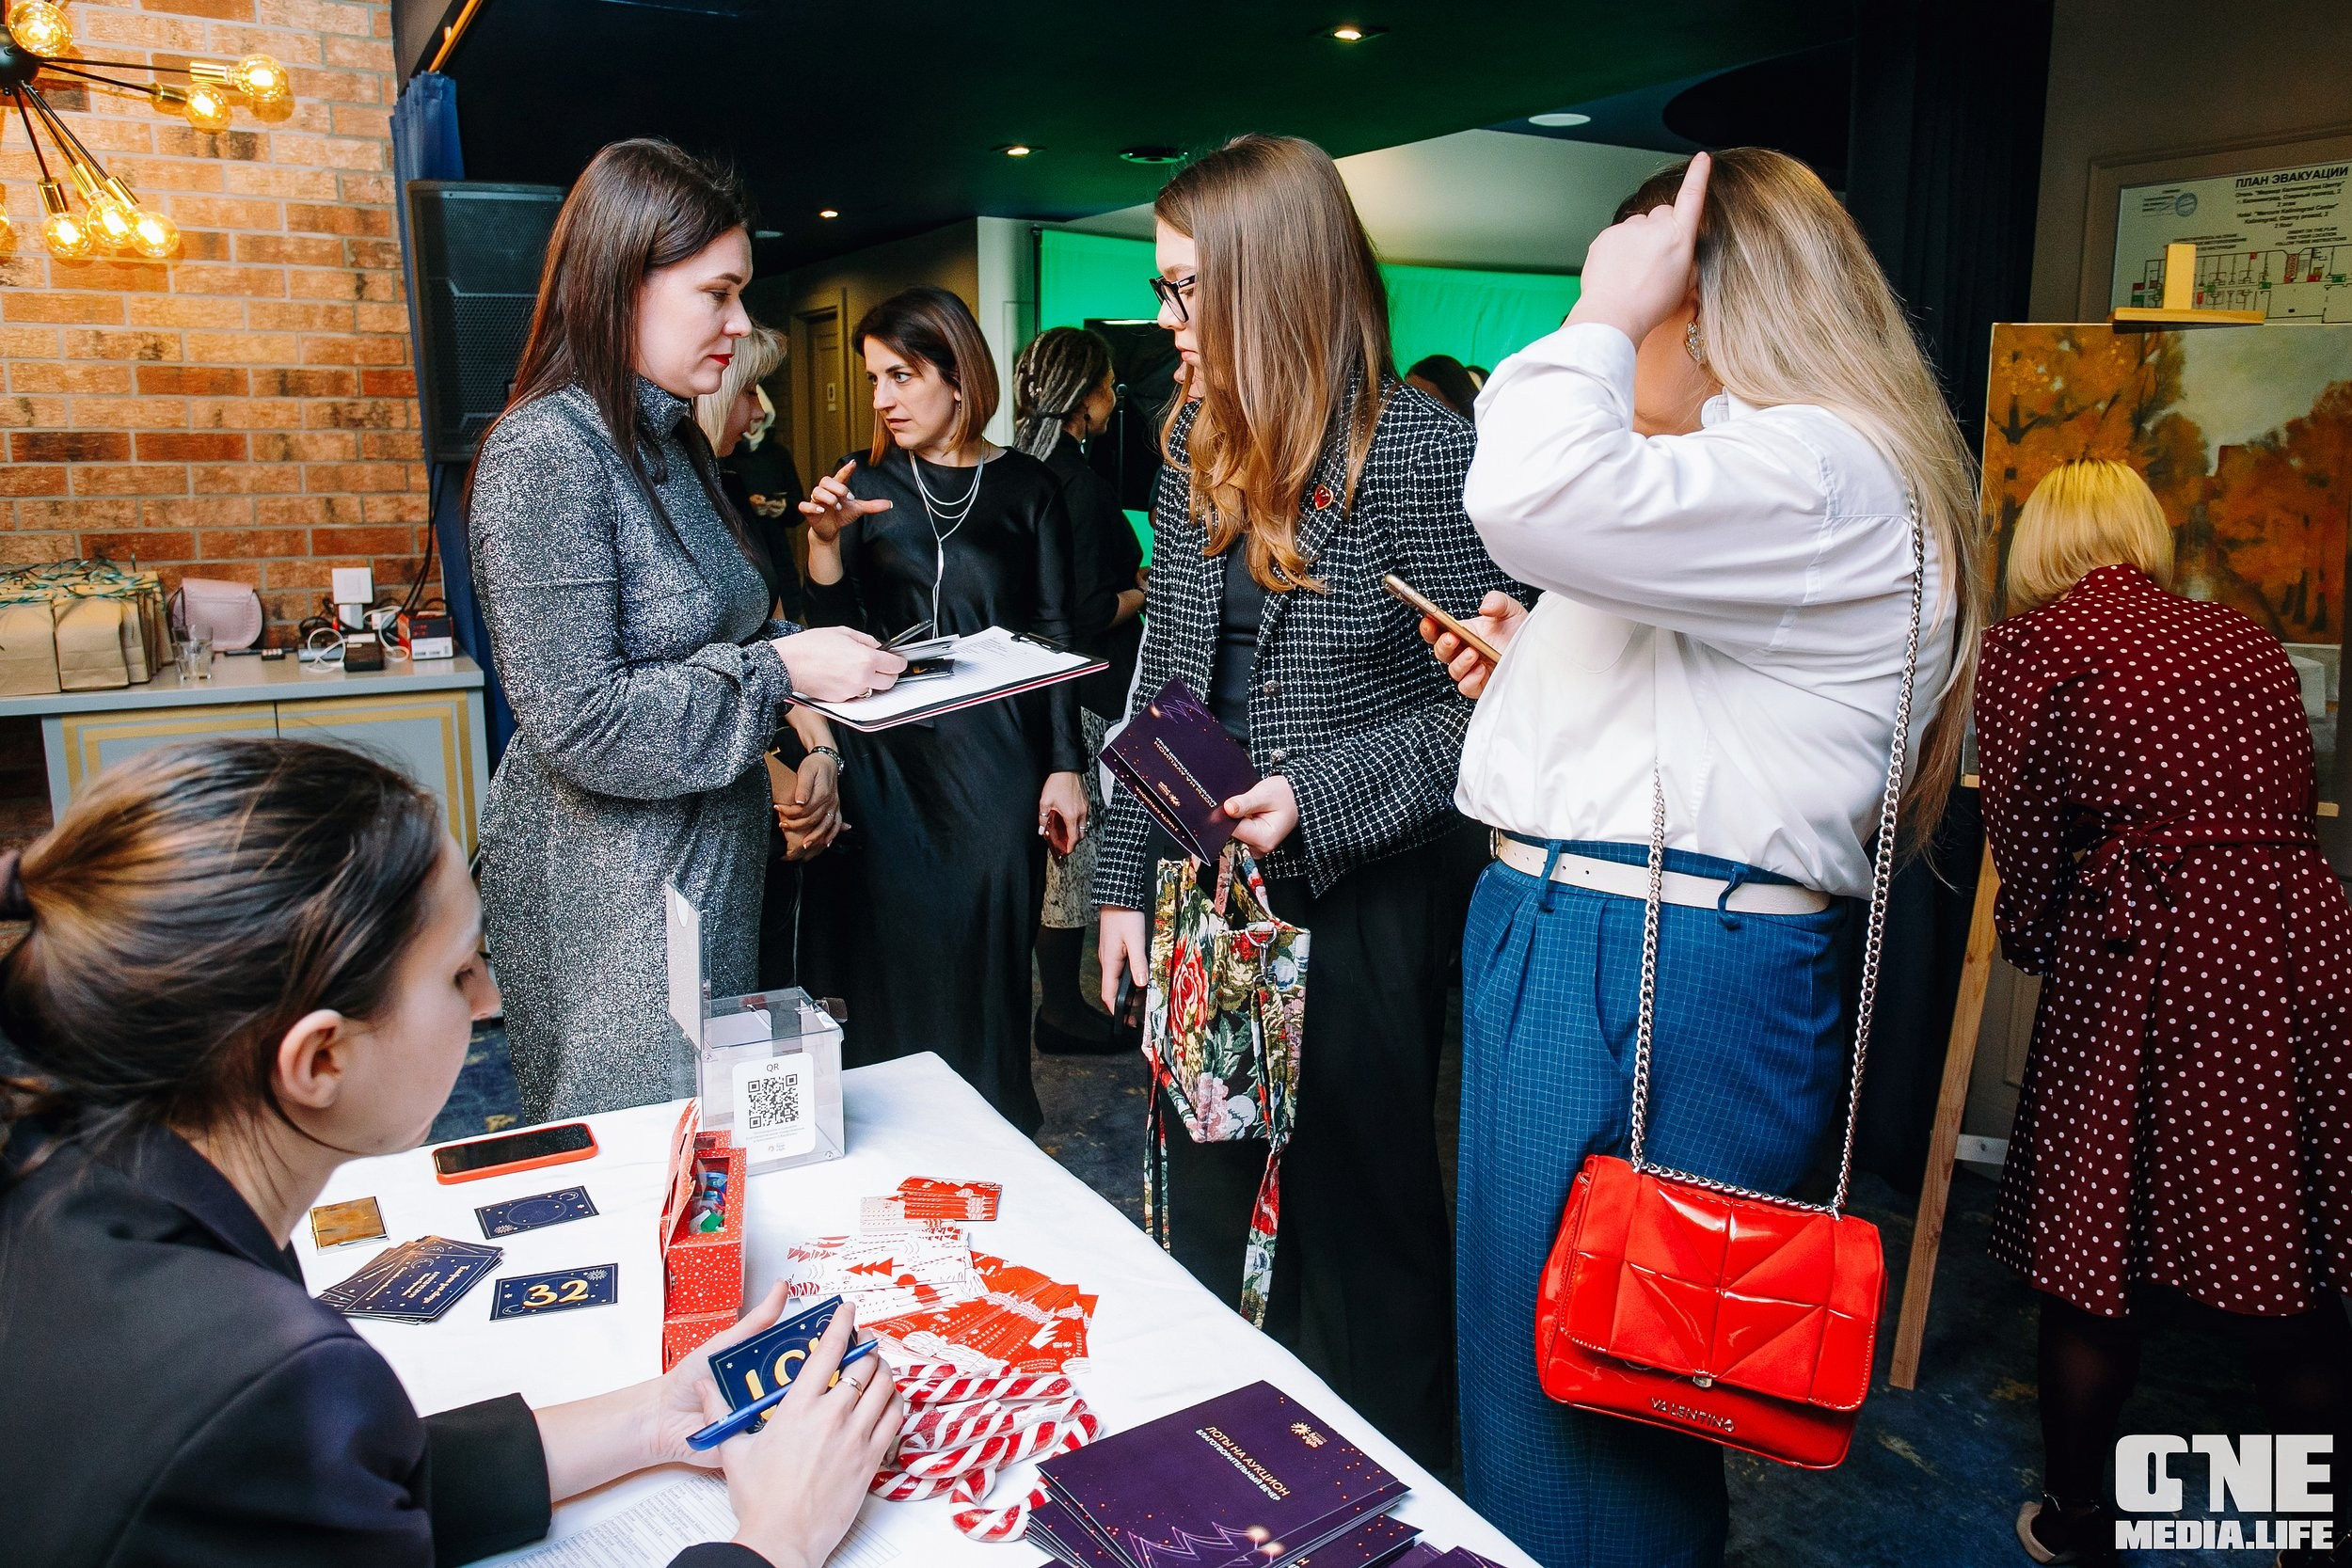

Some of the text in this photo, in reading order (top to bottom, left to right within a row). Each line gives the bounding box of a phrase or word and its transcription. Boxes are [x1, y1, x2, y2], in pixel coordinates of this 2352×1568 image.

[2235, 166, 2349, 189] ПЛАН ЭВАКУАЦИИ
[1153, 740, 1186, 776] АУКЦИОН
[1185, 776, 1197, 788] НА
[1196, 787, 1216, 808] ЛОТЫ
[766, 1063, 780, 1072] QR
[522, 1279, 589, 1308] 32
[1651, 1397, 1736, 1433] VALENTINO
[1196, 1429, 1281, 1501] БЛАГОТВОРИТЕЛЬНЫЙ ВЕЧЕР
[1205, 1426, 1291, 1497] ЛОТЫ НА АУКЦИОН
